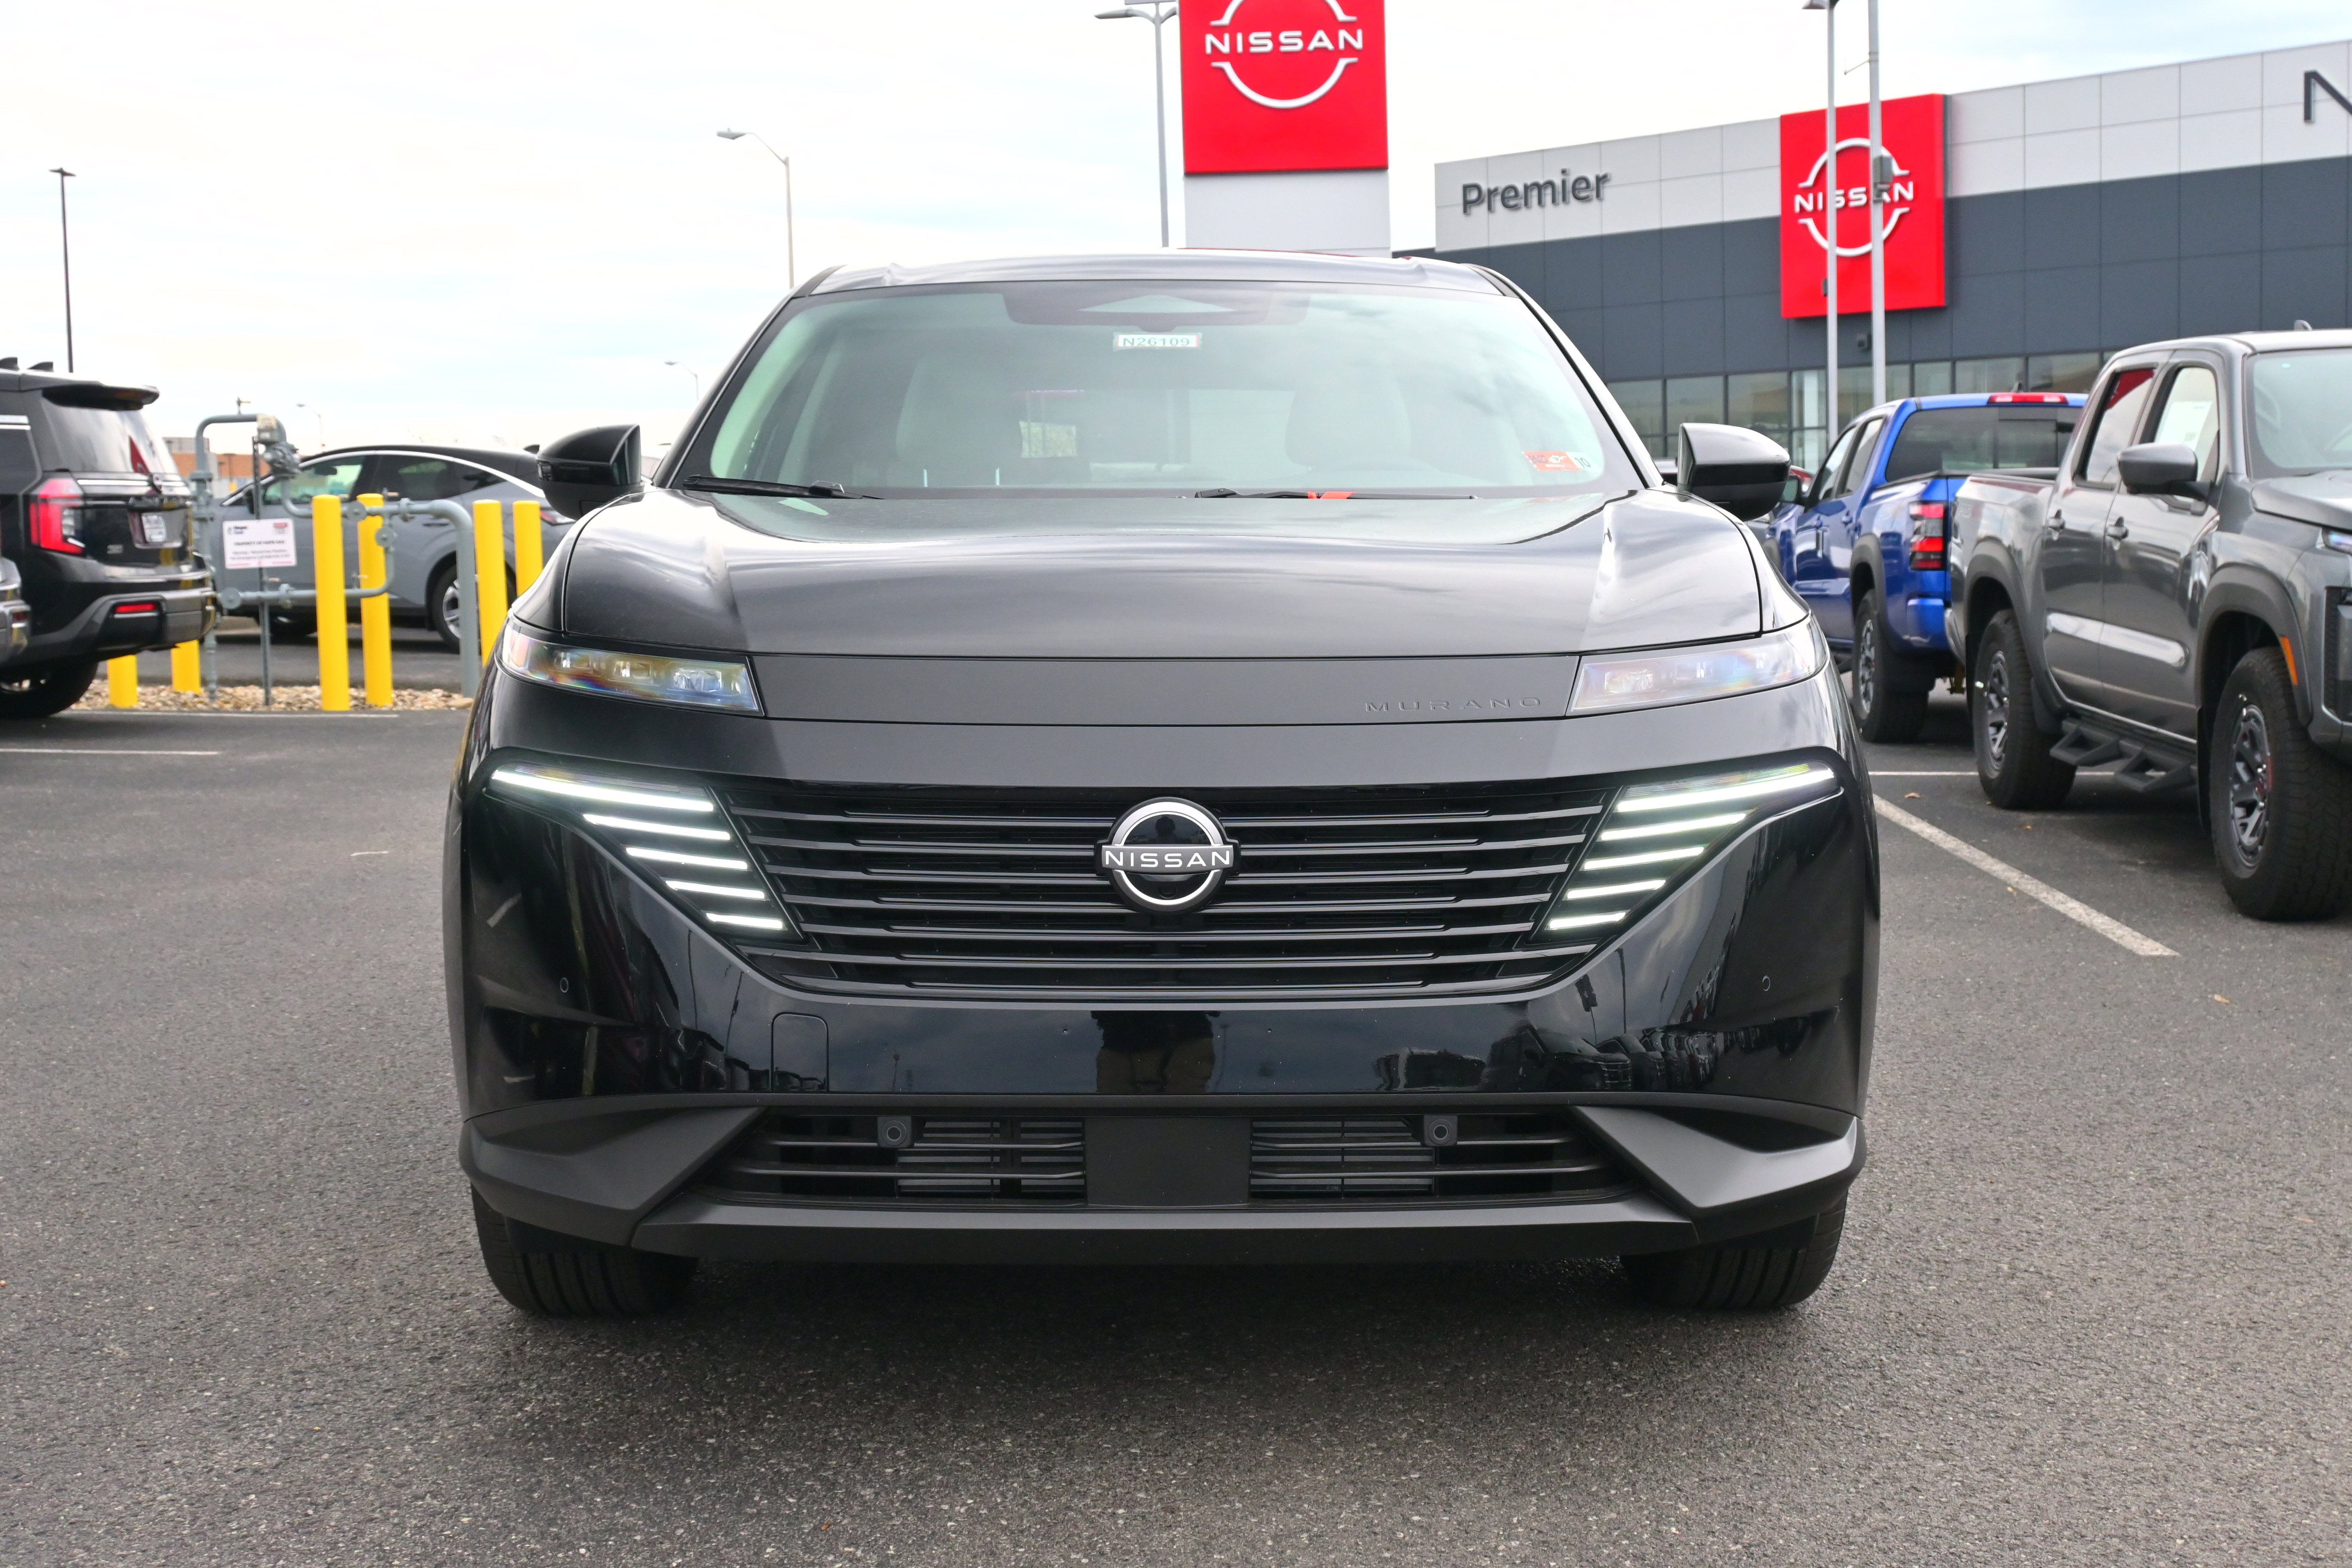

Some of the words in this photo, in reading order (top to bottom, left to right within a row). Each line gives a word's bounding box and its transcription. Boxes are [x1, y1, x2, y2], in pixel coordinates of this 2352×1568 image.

[1205, 29, 1364, 55] NISSAN
[1462, 168, 1609, 215] Premier
[1123, 338, 1190, 346] N26109
[1365, 697, 1541, 712] MURANO
[1105, 850, 1230, 868] NISSAN
